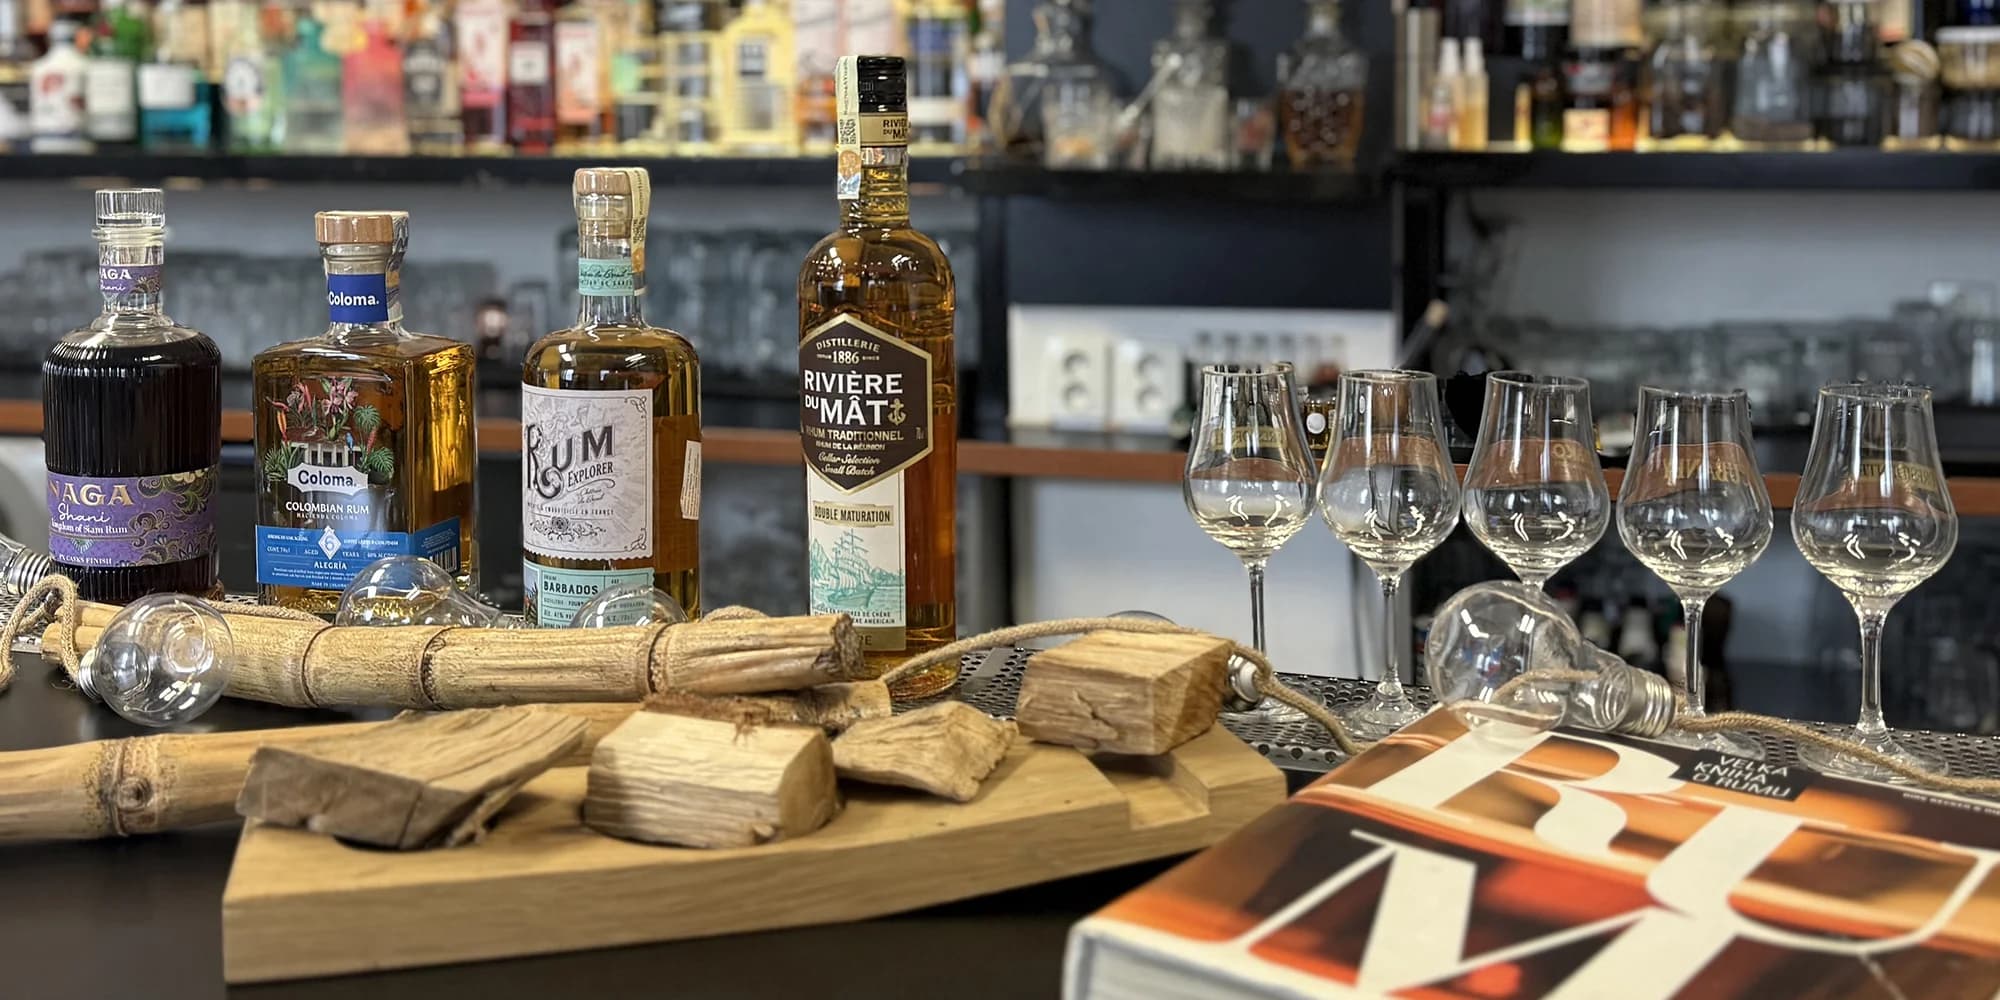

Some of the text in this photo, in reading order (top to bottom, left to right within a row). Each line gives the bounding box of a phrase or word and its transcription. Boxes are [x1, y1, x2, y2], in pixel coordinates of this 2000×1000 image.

[816, 337, 881, 353] DISTILLERIE
[832, 350, 860, 364] 1886
[804, 369, 903, 395] RIVIÈRE
[805, 395, 889, 426] DU MÂT
[806, 426, 825, 438] RHUM
[827, 429, 904, 441] TRADITIONNEL
[525, 424, 616, 499] RUM
[567, 461, 614, 487] EXPLORER
[820, 463, 875, 477] Small Batch
[48, 480, 135, 506] NAGA
[58, 502, 111, 523] Shani
[285, 501, 369, 515] COLOMBIAN RUM
[814, 505, 891, 522] DOUBLE MATURATION
[75, 524, 83, 533] of
[84, 525, 104, 534] Siam
[105, 525, 128, 534] Rum
[324, 536, 335, 551] 6
[86, 557, 112, 565] FINISH
[543, 581, 599, 595] BARBADOS
[1694, 761, 1767, 785] KNIHA
[1692, 772, 1792, 797] O RUMU
